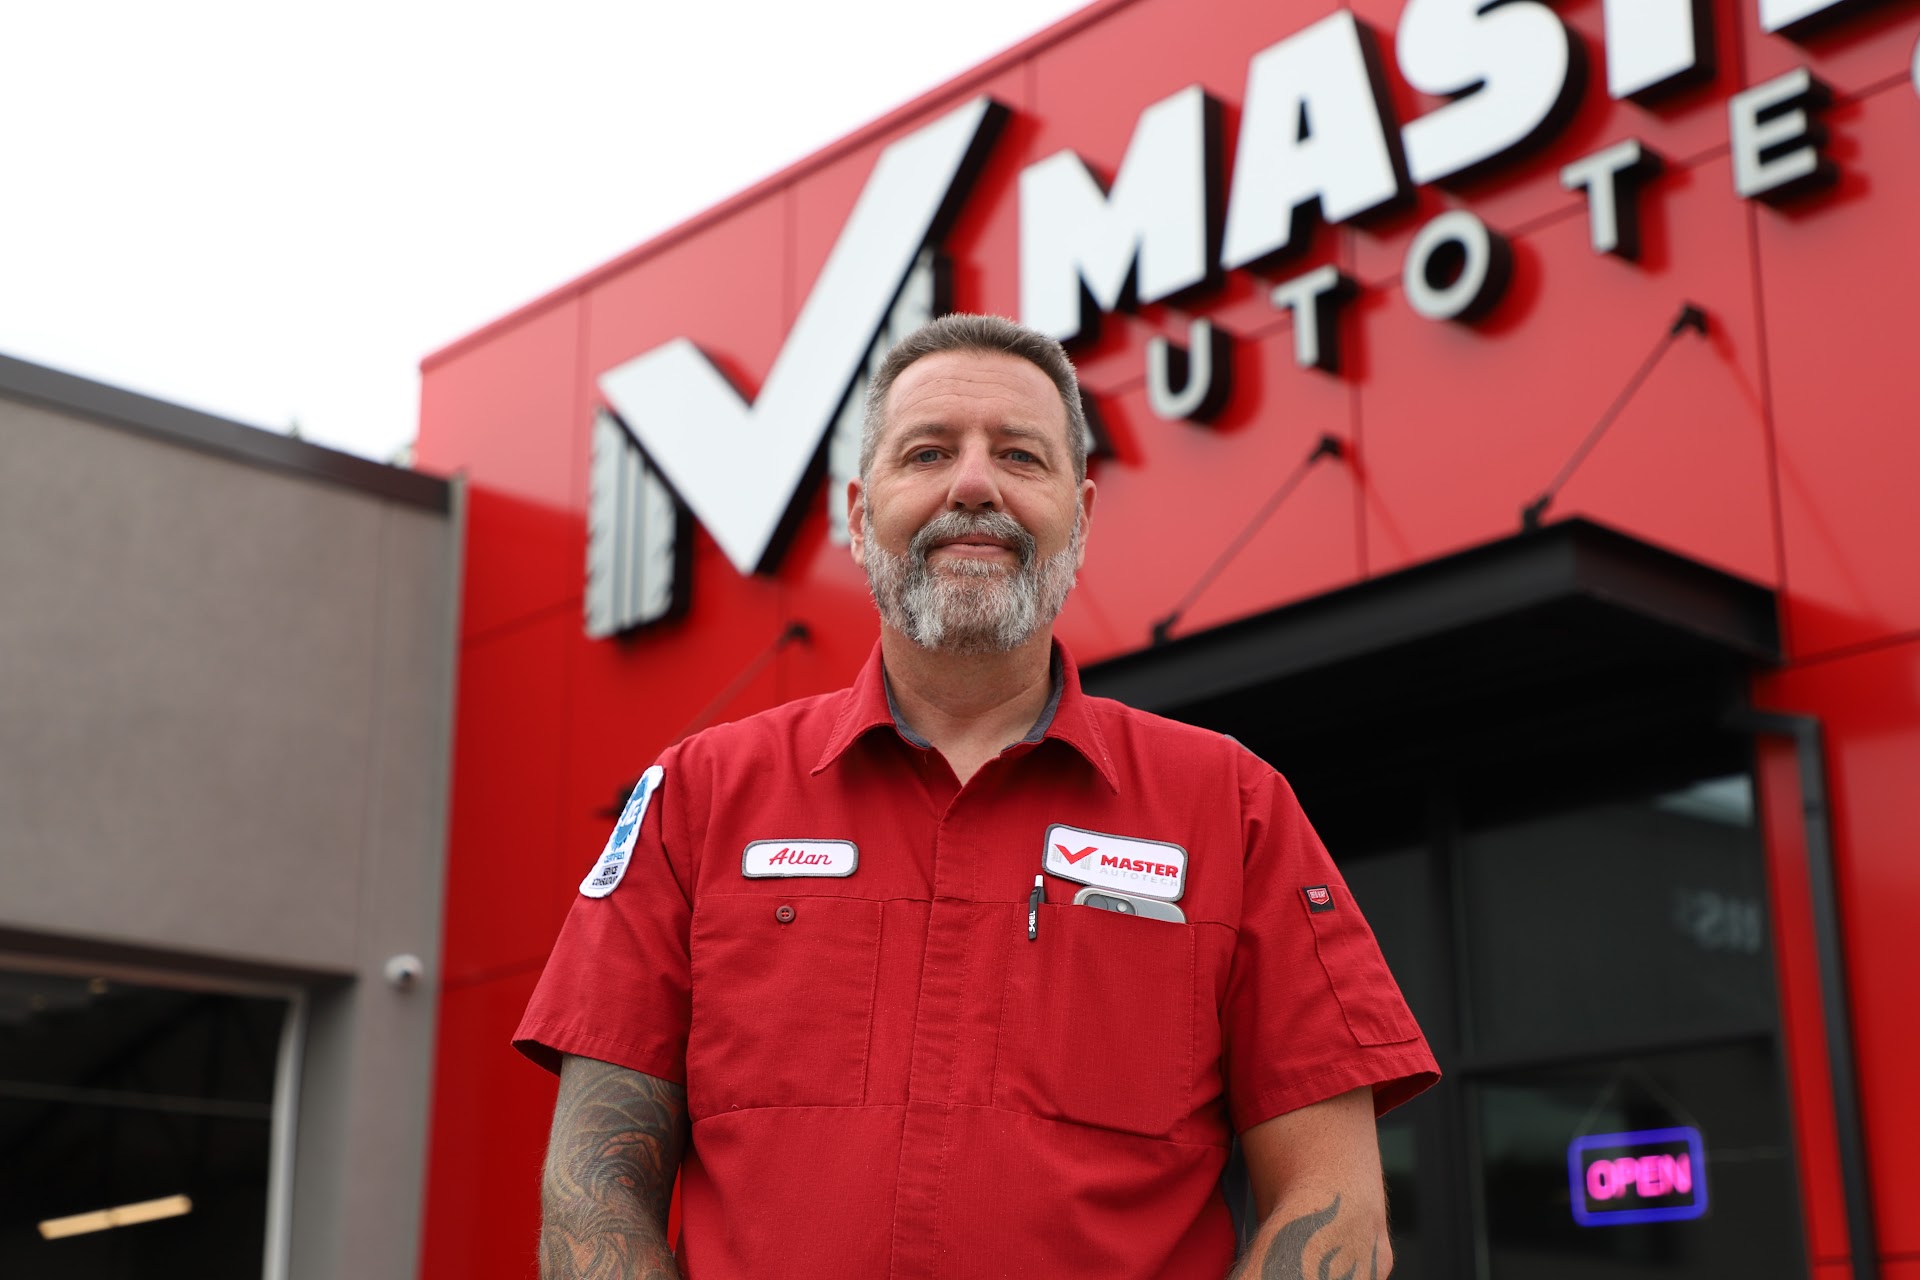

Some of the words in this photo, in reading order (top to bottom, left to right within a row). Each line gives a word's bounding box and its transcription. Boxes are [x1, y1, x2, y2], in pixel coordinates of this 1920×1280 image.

[769, 847, 832, 865] Allan
[1100, 855, 1179, 878] MASTER
[1099, 867, 1178, 887] AUTOTECH
[1586, 1152, 1692, 1200] OPEN
